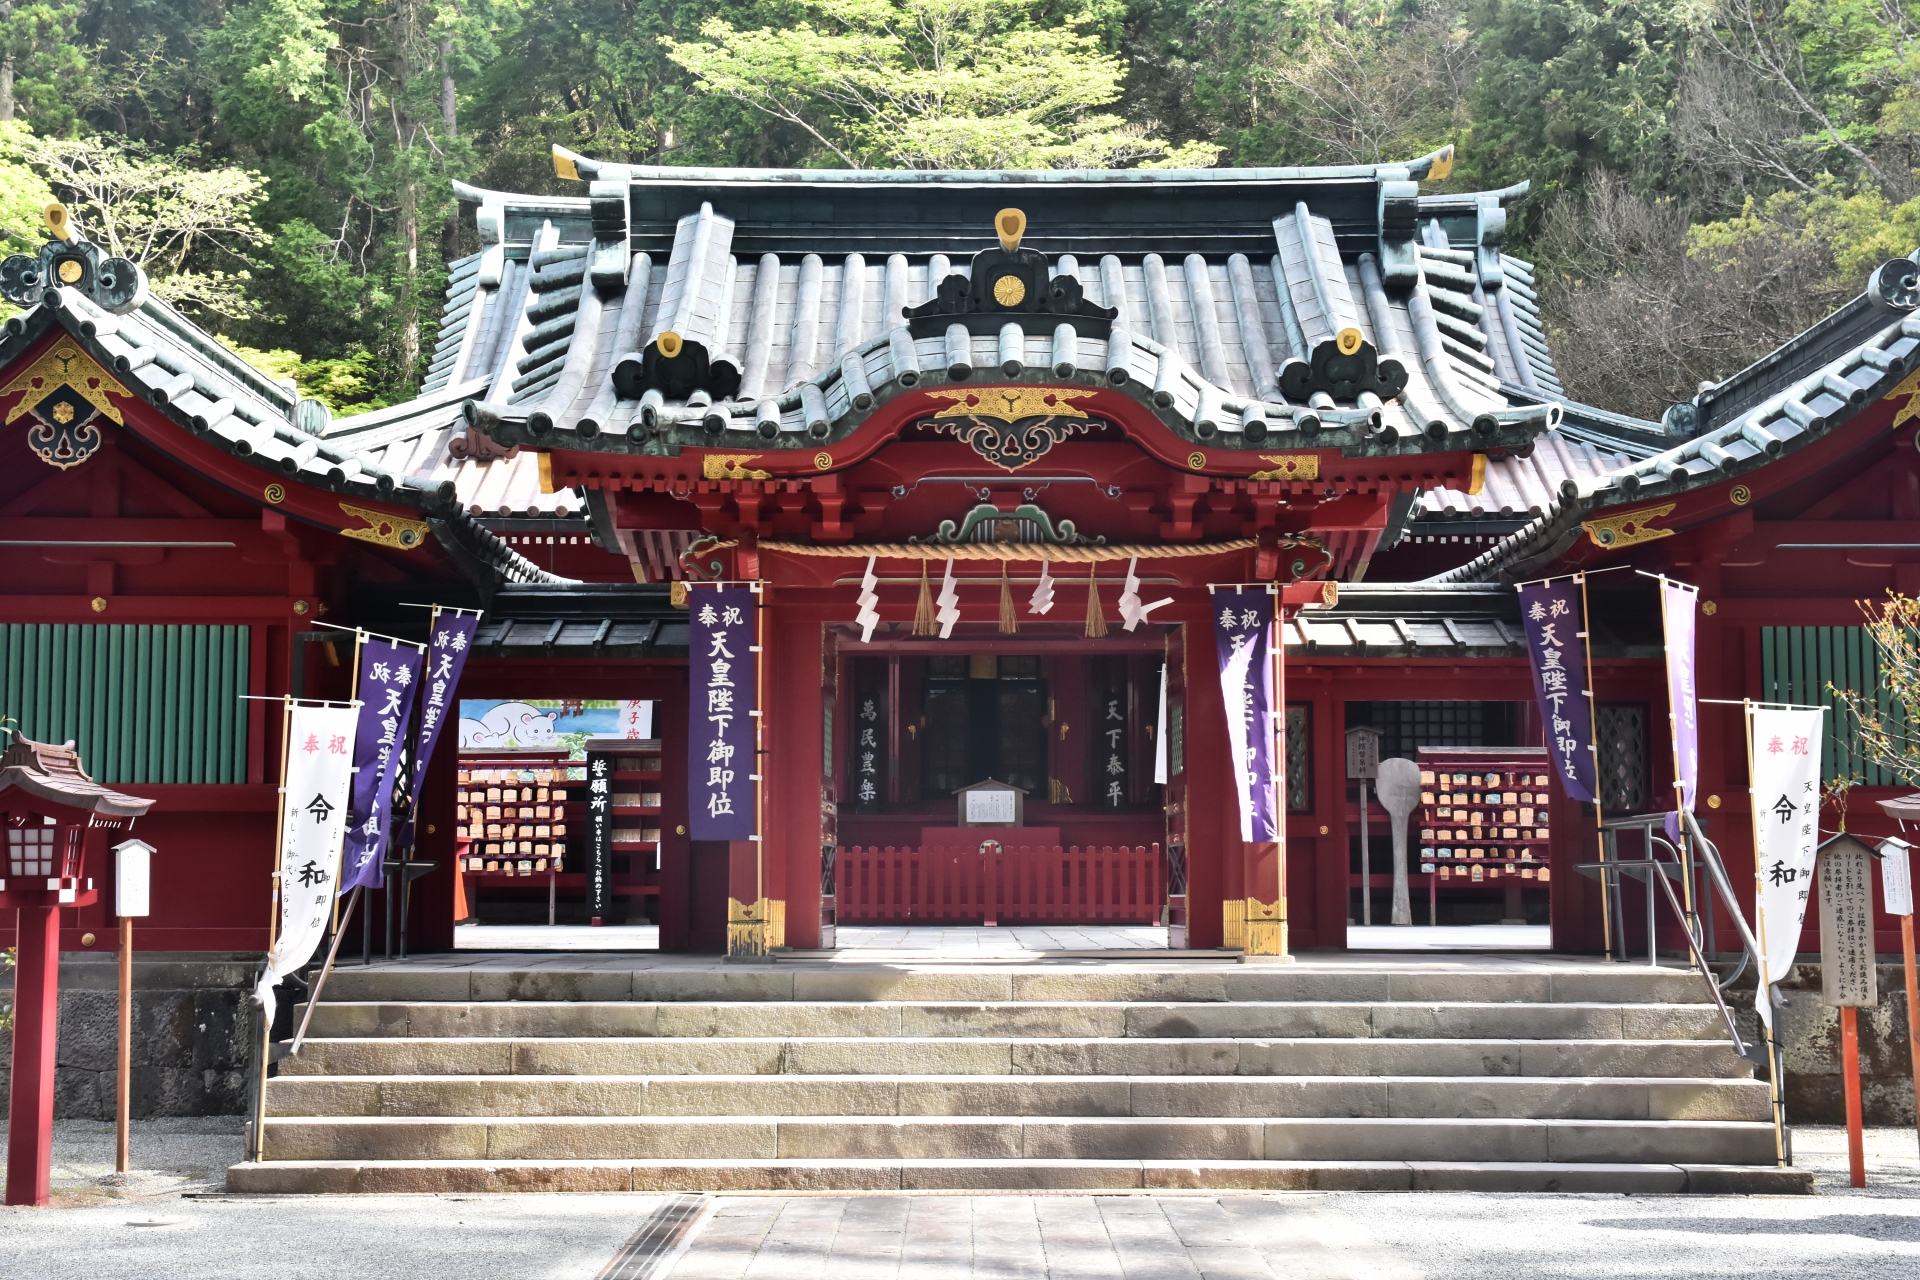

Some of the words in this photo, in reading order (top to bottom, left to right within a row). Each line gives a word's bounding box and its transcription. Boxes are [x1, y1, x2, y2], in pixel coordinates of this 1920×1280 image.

[697, 603, 744, 628] 奉祝
[1219, 606, 1262, 631] 奉祝
[1528, 599, 1570, 622] 奉祝
[302, 733, 348, 755] 奉祝
[707, 631, 735, 818] 天皇陛下御即位
[1106, 699, 1125, 807] 天下泰平
[1767, 734, 1809, 755] 奉祝
[590, 759, 608, 813] 誓願所
[297, 792, 335, 888] 令和
[1769, 793, 1798, 888] 令和
